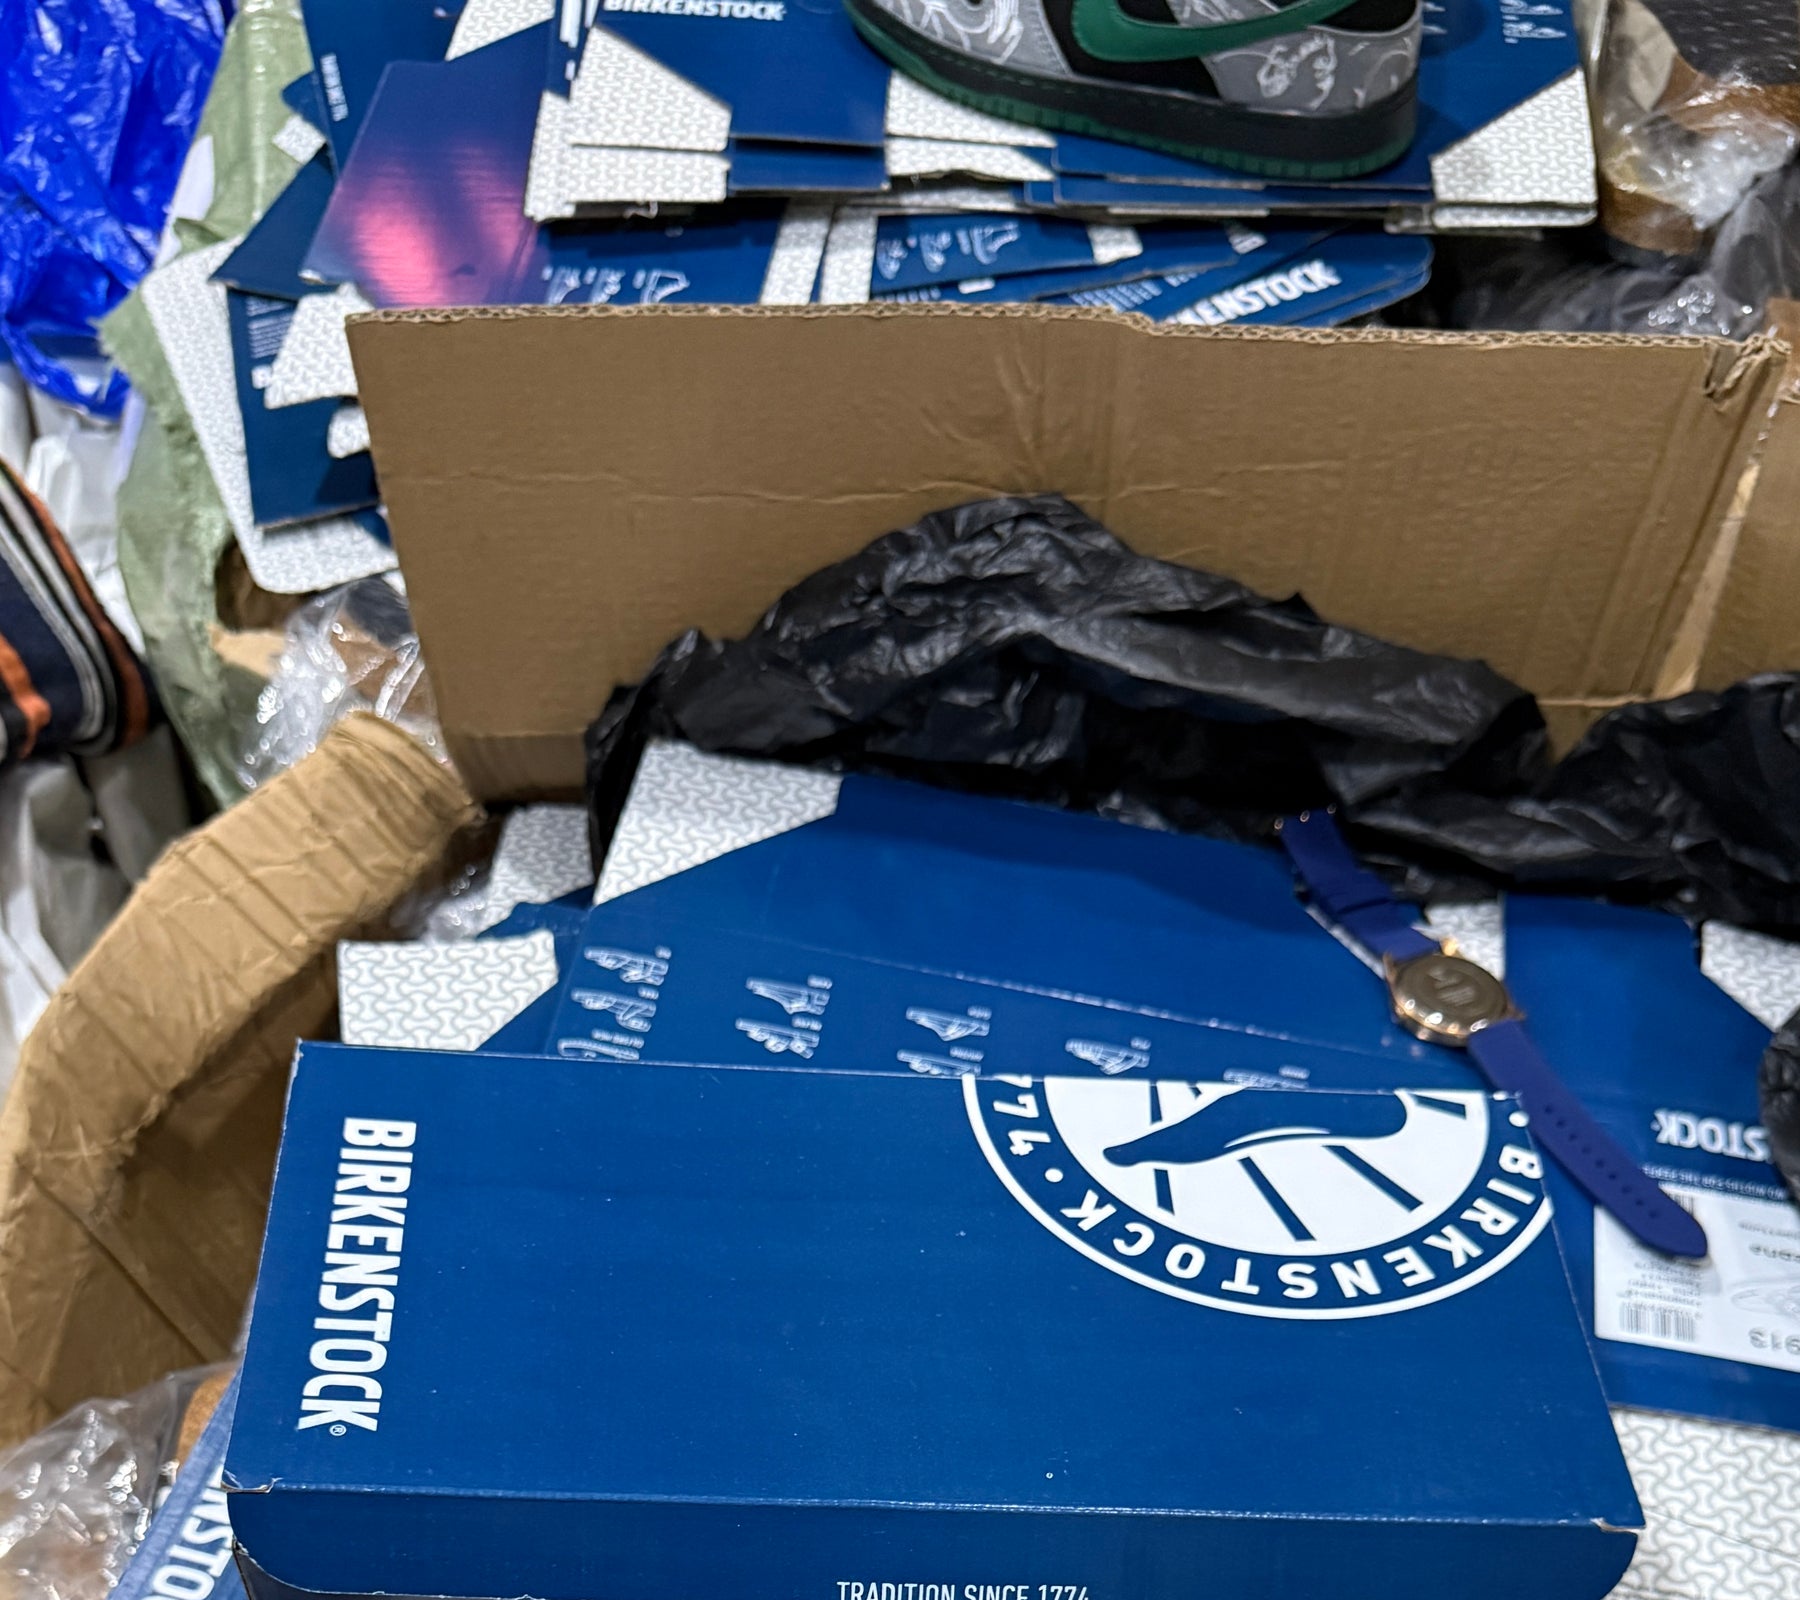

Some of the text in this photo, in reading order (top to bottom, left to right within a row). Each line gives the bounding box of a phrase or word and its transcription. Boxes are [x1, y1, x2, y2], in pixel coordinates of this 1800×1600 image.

[603, 0, 784, 21] BIRKENSTOCK
[298, 1117, 417, 1431] BIRKENSTOCK
[1060, 1143, 1543, 1299] BIRKENSTOCK
